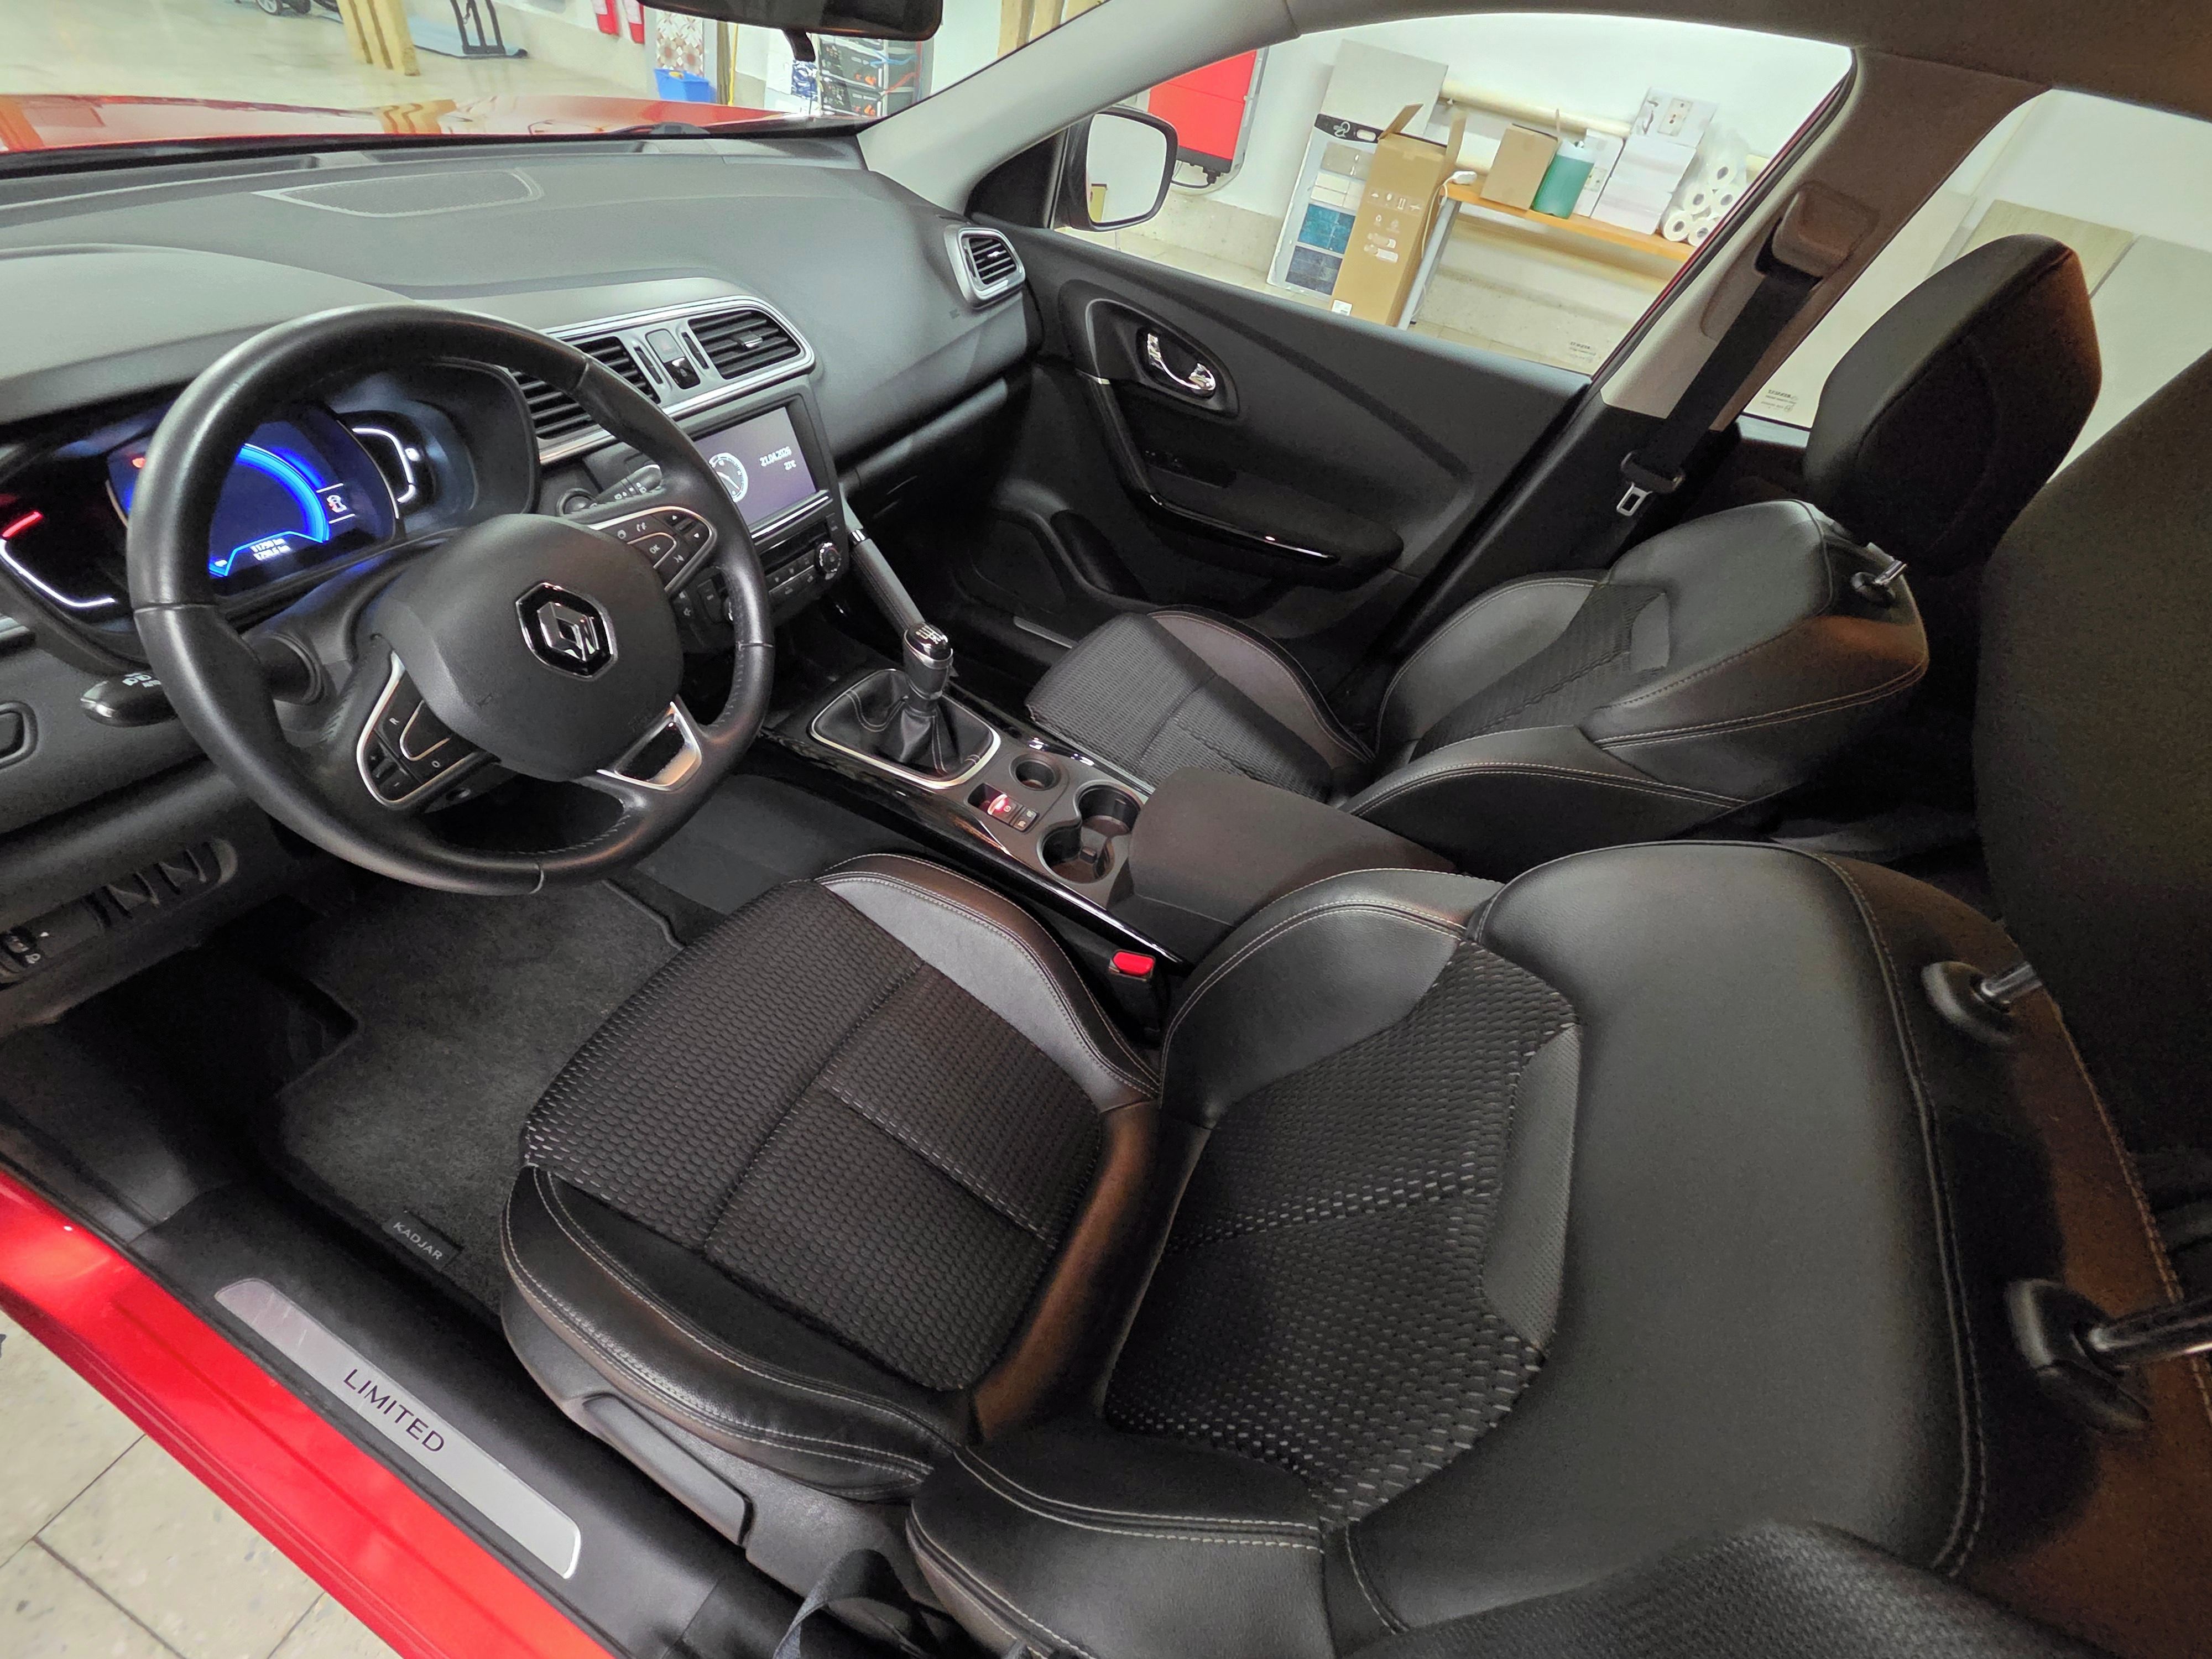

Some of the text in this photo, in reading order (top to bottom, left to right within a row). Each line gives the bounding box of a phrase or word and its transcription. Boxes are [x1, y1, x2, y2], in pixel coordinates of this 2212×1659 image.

[649, 544, 661, 554] OK
[393, 1221, 444, 1261] KADJAR
[343, 1368, 445, 1453] LIMITED
